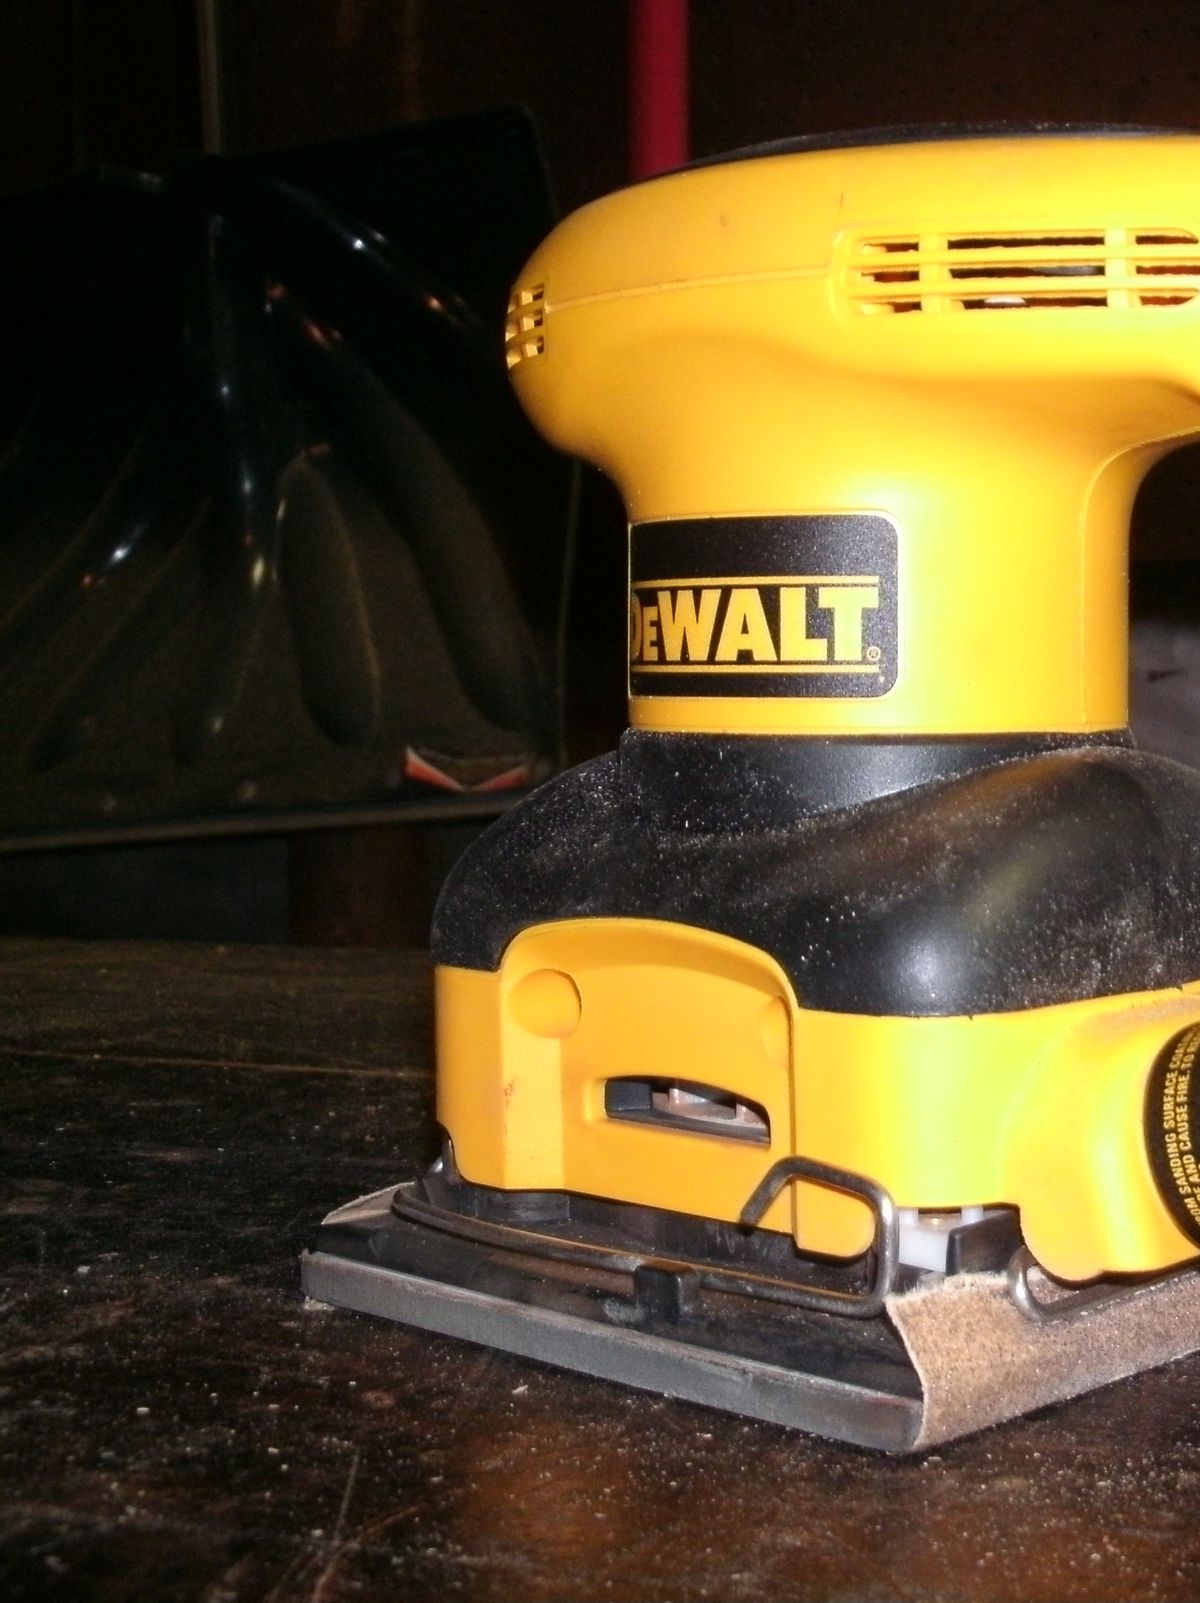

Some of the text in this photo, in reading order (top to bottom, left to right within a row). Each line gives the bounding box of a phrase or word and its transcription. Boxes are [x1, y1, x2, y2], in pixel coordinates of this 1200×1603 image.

[1180, 1053, 1195, 1070] TO
[1163, 1070, 1177, 1129] SURFACE
[1176, 1069, 1190, 1103] FIRE.
[1175, 1103, 1192, 1151] CAUSE
[1164, 1132, 1192, 1194] SANDING
[1182, 1153, 1200, 1183] AND
